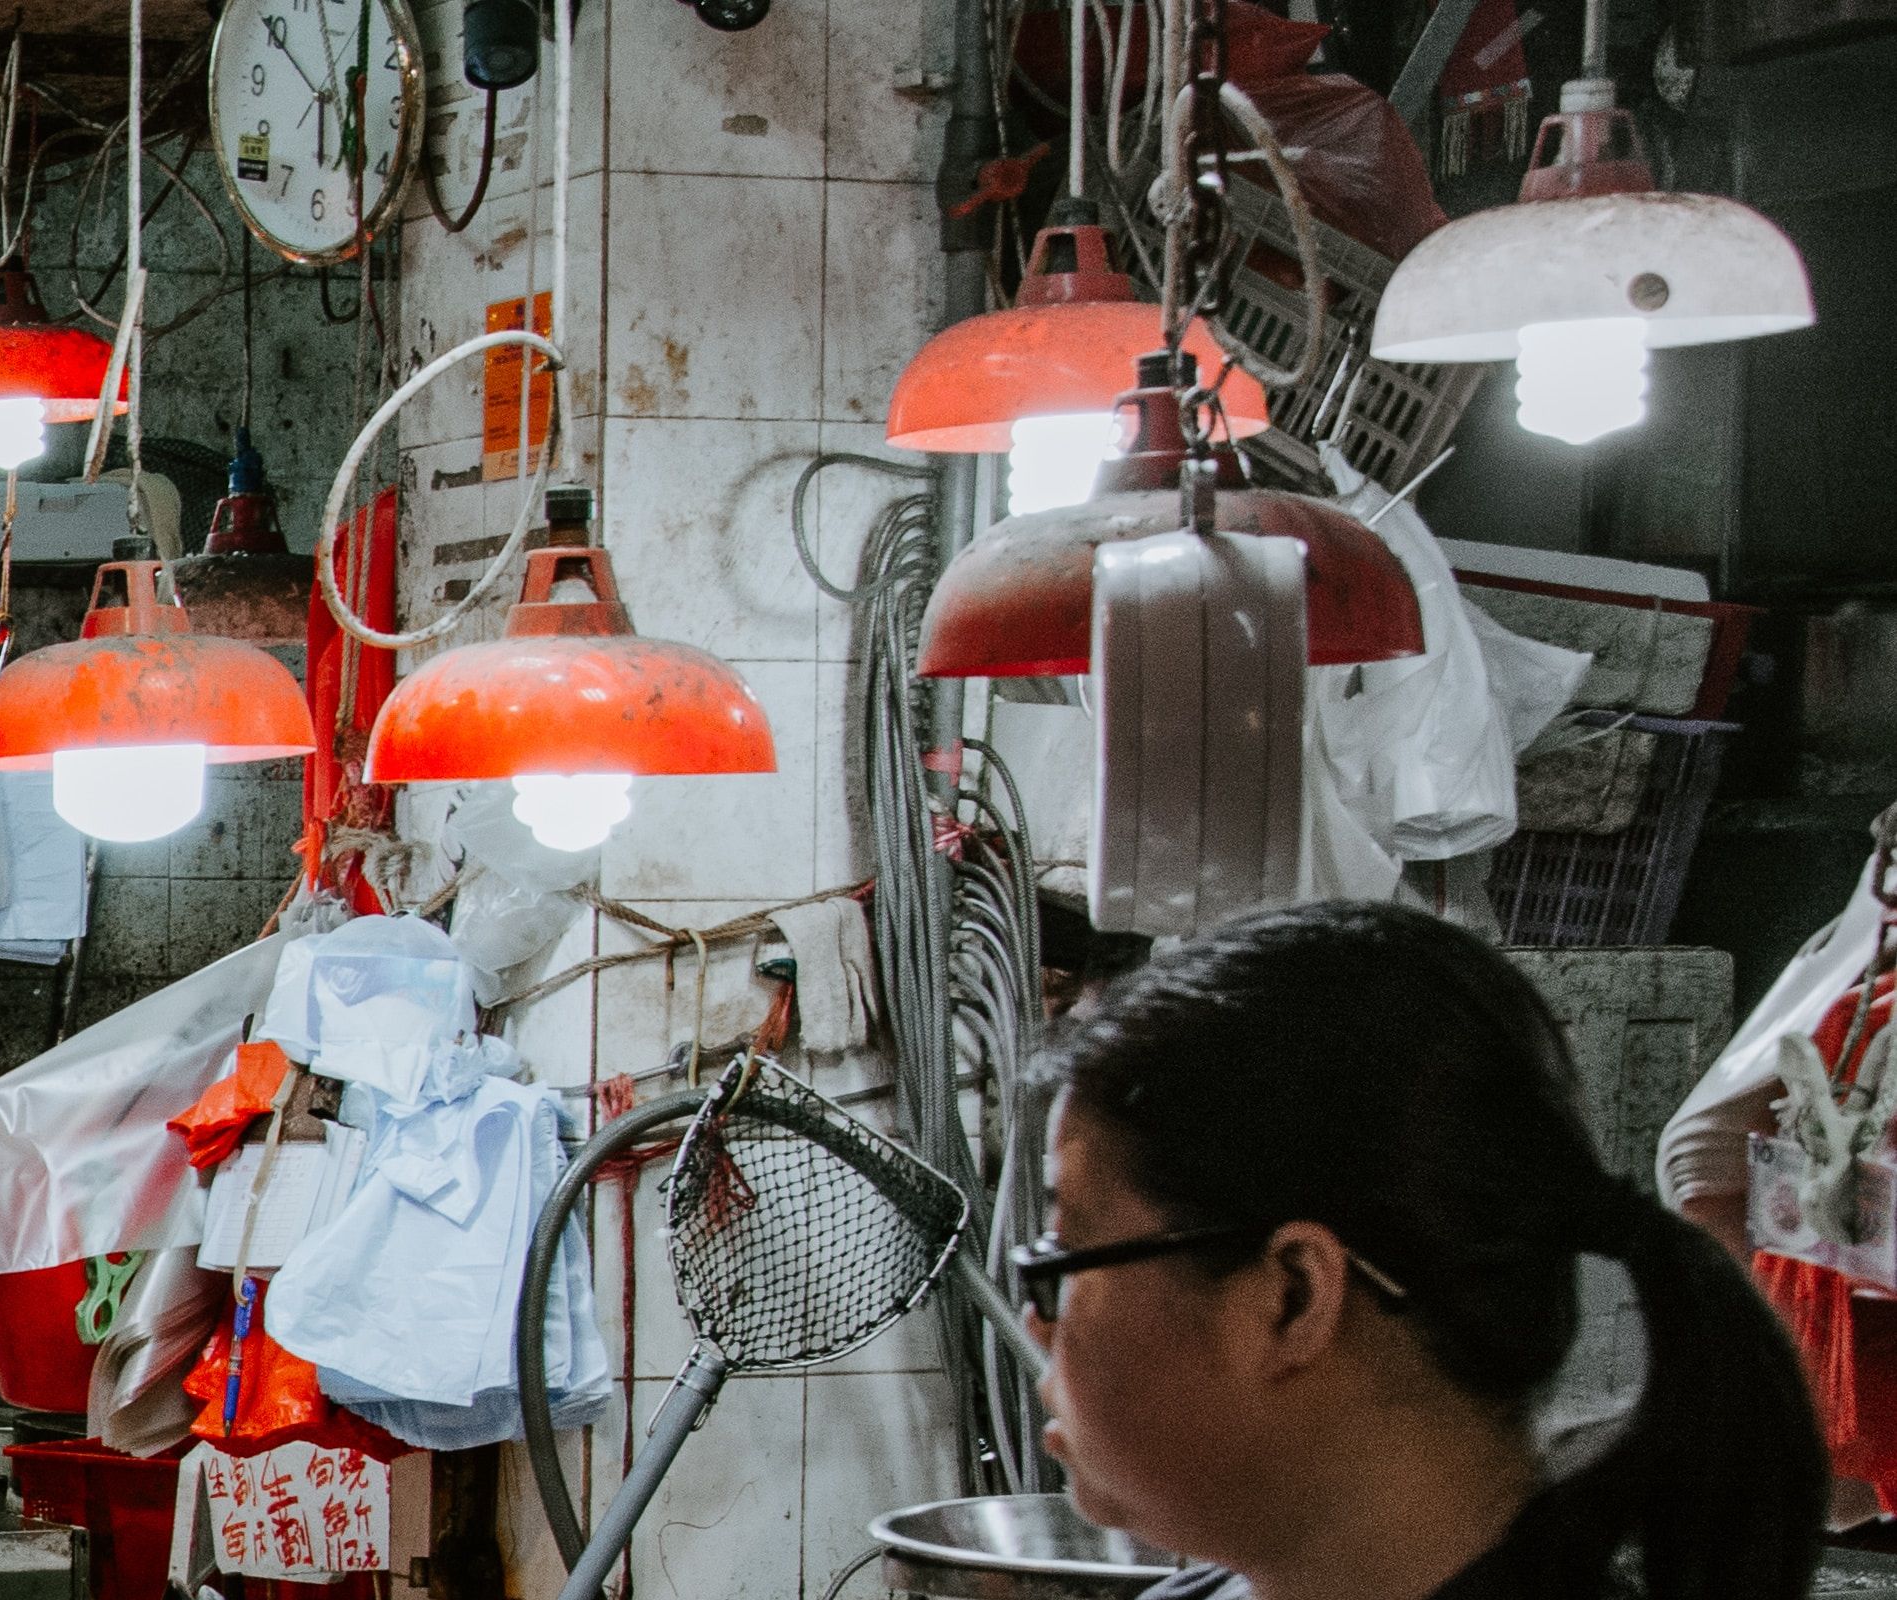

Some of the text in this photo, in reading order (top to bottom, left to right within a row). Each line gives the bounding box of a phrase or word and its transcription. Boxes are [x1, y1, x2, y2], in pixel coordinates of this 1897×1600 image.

[252, 64, 265, 96] 9
[375, 152, 388, 176] 4
[281, 164, 294, 197] 7
[311, 189, 325, 221] 6
